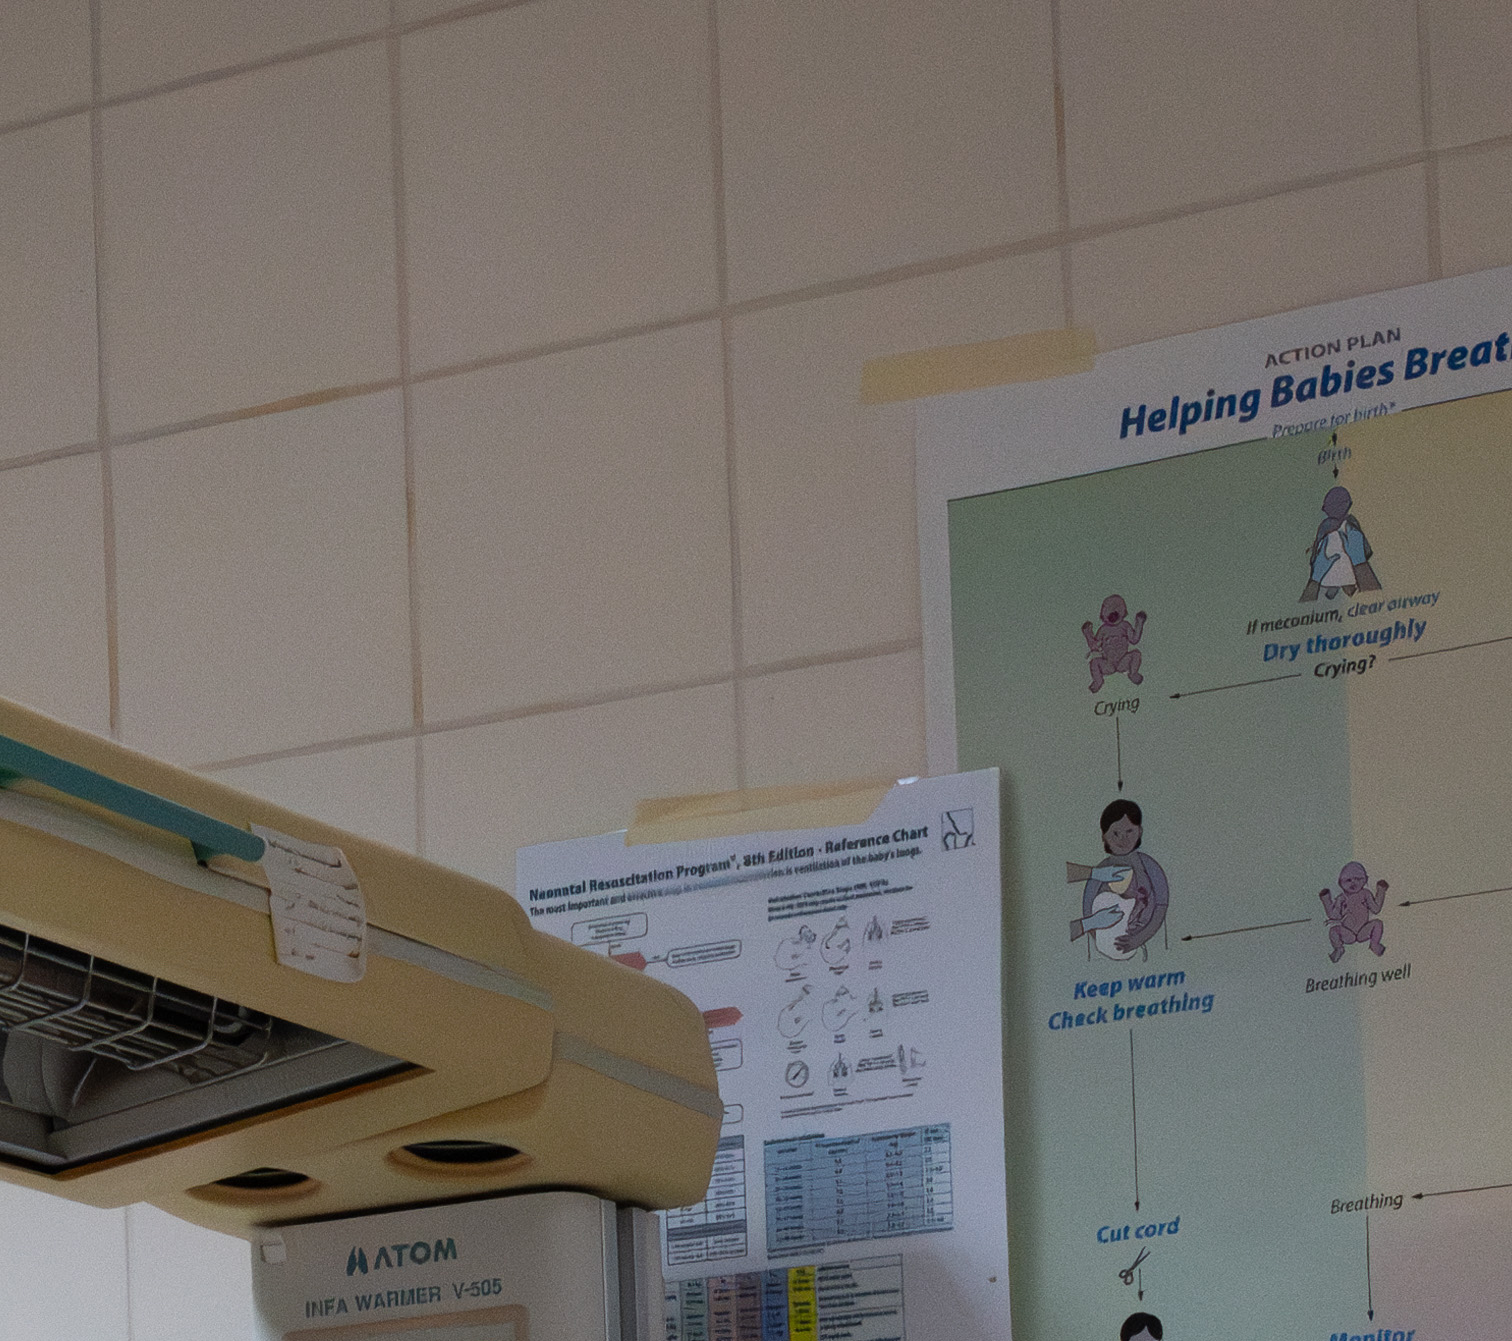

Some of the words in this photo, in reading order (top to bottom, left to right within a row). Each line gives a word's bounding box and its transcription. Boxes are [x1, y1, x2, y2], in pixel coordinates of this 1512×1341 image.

[1264, 338, 1343, 369] ACTION
[1347, 326, 1402, 351] PLAN
[1118, 387, 1262, 440] Helping
[1269, 358, 1396, 409] Babies
[1271, 417, 1328, 439] Prepare
[1330, 411, 1352, 427] for
[1317, 446, 1353, 465] Birth
[1246, 618, 1259, 636] If
[1260, 607, 1344, 633] meconium,
[1346, 601, 1386, 618] clear
[1387, 590, 1441, 612] airway
[1262, 642, 1301, 663] Dry
[1305, 617, 1428, 655] thoroughly
[1313, 654, 1377, 680] Crying?
[1093, 693, 1142, 720] Crying
[528, 879, 587, 902] Neonatal
[588, 868, 674, 893] Resuscitation
[743, 849, 766, 868] 8th
[768, 846, 815, 864] Edition
[824, 835, 890, 854] Reference
[892, 825, 929, 843] Chart
[568, 895, 609, 913] important
[1073, 979, 1123, 1001] Keep
[1127, 970, 1186, 992] warm
[1304, 968, 1378, 997] Breathing
[1381, 962, 1413, 986] well
[1048, 1005, 1109, 1031] Check
[1112, 992, 1216, 1022] breathing
[1330, 1192, 1404, 1215] Breathing
[1095, 1220, 1132, 1246] Cut
[1134, 1214, 1181, 1241] cord
[374, 1237, 458, 1270] ATOM
[305, 1295, 349, 1318] INFA
[355, 1285, 442, 1312] WARMER
[452, 1277, 503, 1300] V-505
